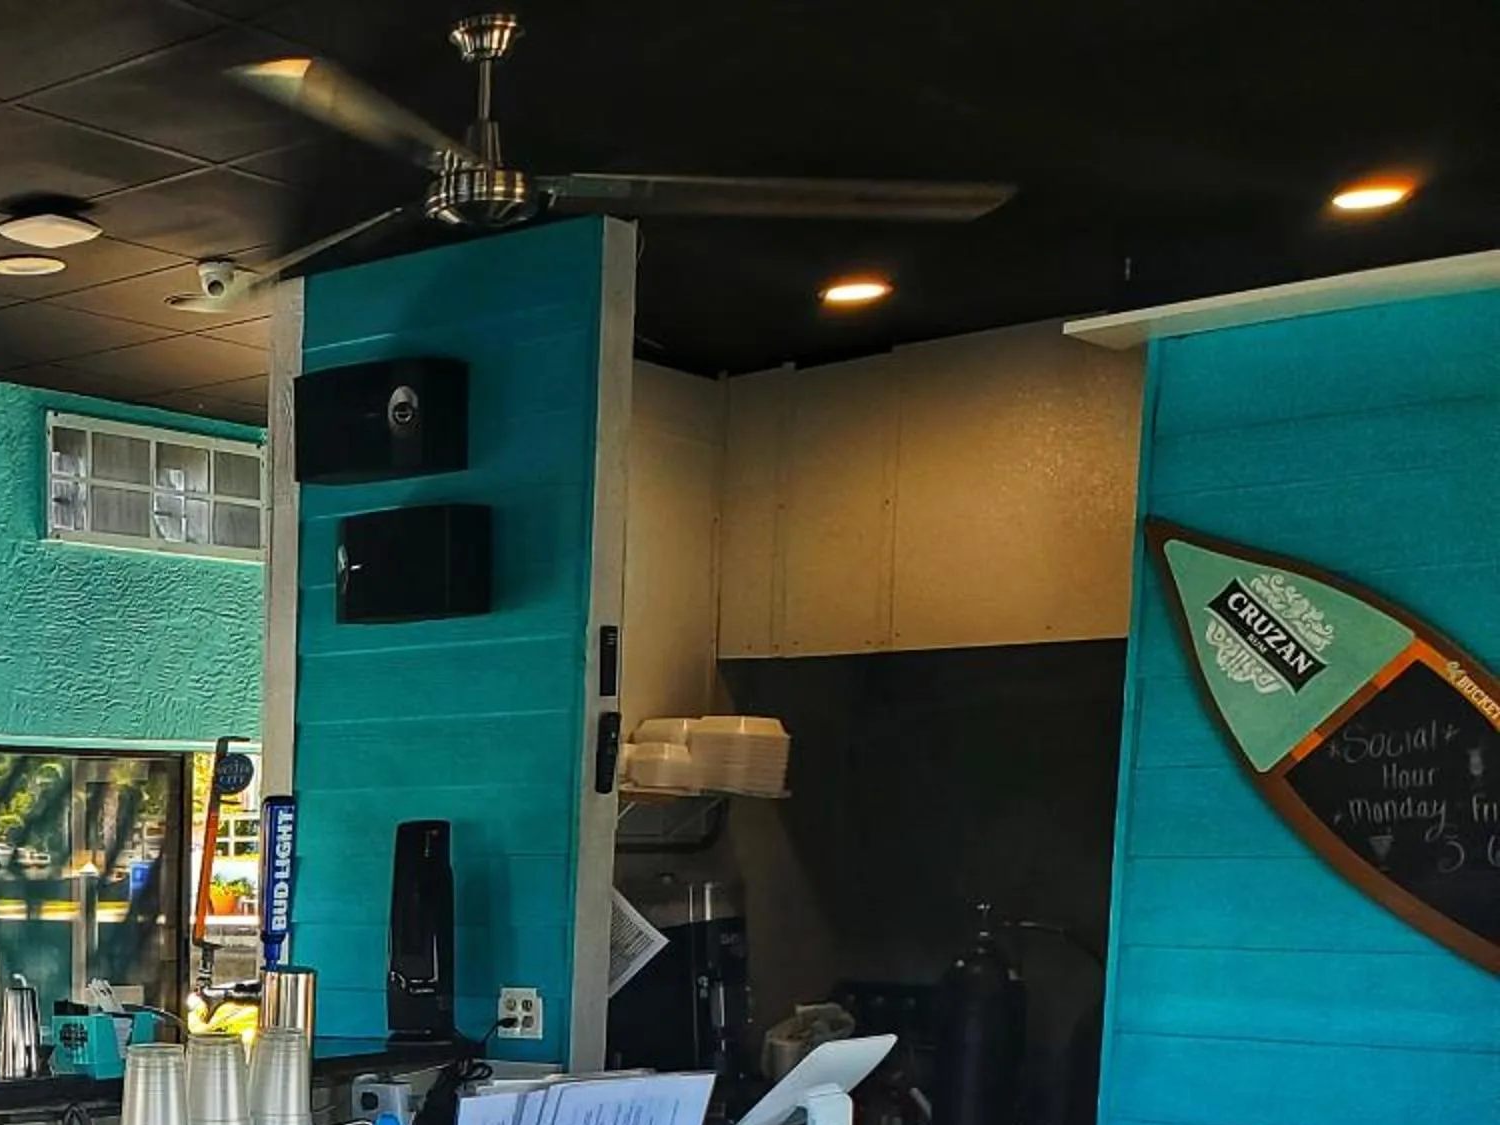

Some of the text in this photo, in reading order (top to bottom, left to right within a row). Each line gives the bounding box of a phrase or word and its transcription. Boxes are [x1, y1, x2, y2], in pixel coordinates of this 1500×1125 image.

[1227, 592, 1315, 676] CRUZAN
[1343, 720, 1438, 763] Social
[1382, 762, 1436, 790] Hour
[271, 809, 294, 931] BUD LIGHT
